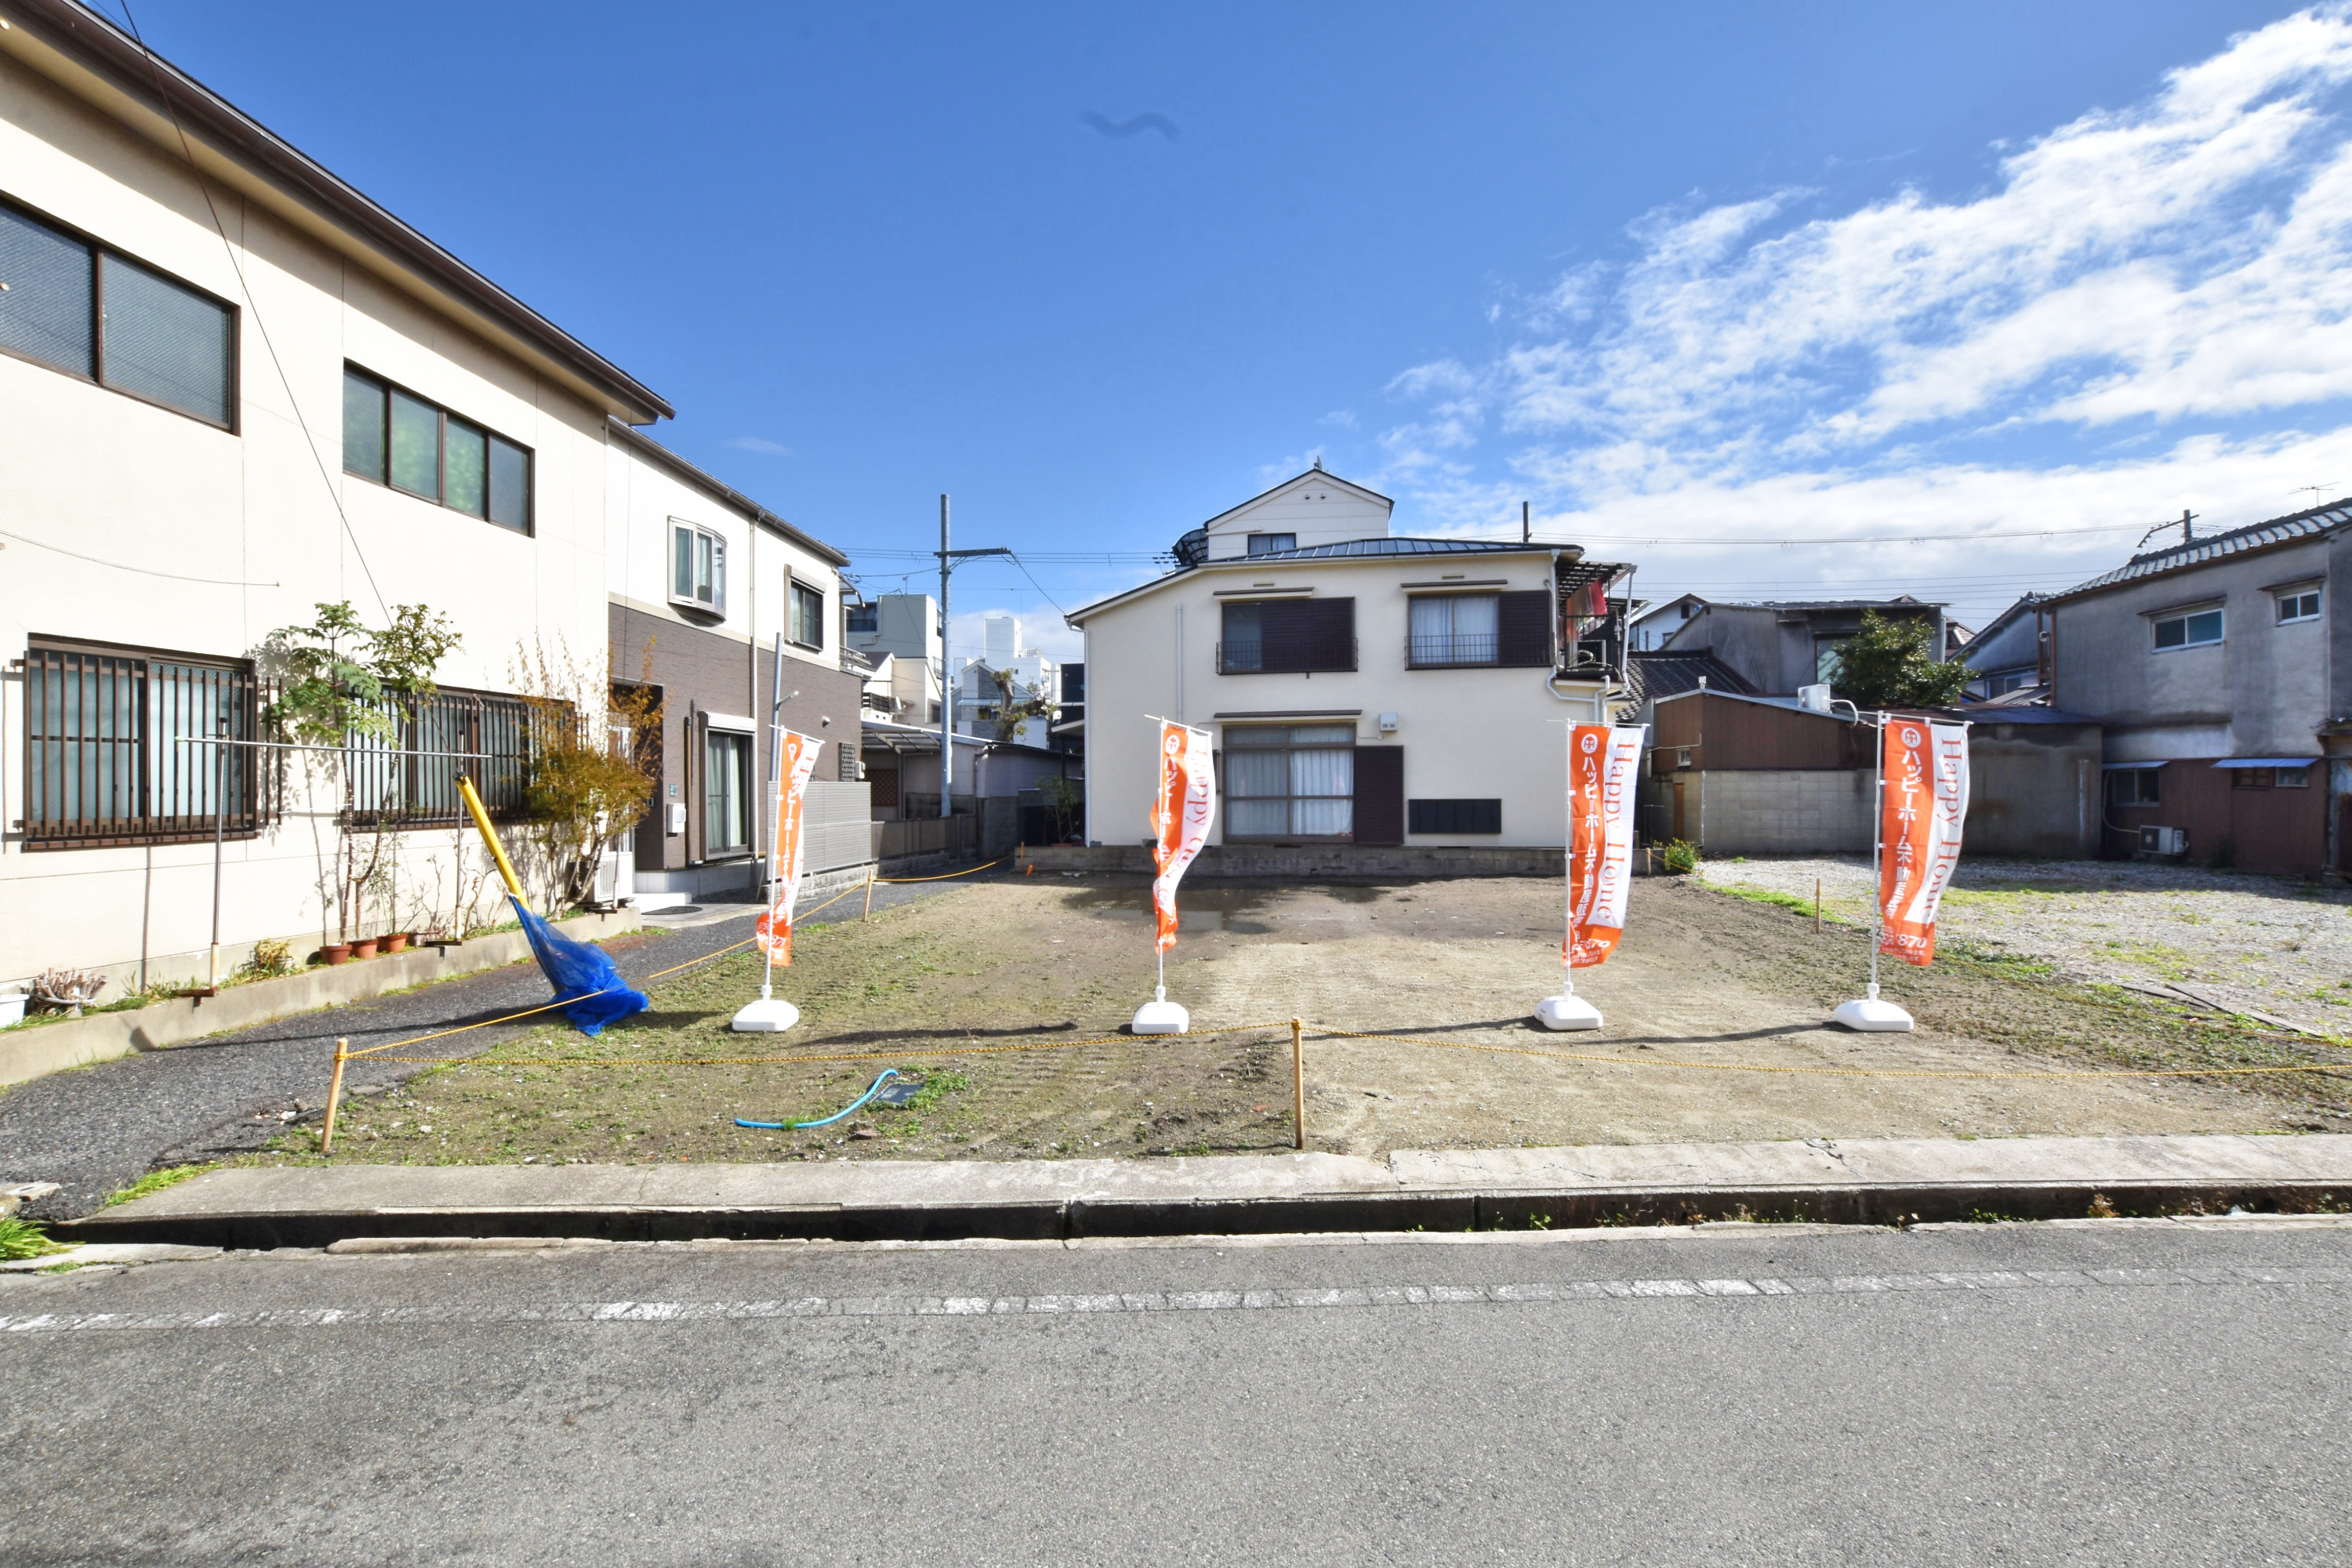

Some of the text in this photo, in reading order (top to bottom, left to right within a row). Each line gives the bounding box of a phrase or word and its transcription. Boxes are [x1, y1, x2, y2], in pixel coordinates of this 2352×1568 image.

[1597, 742, 1636, 920] Happy Home
[1886, 750, 1922, 919] ハッピーホーム不動産
[1918, 738, 1963, 924] Happy Home
